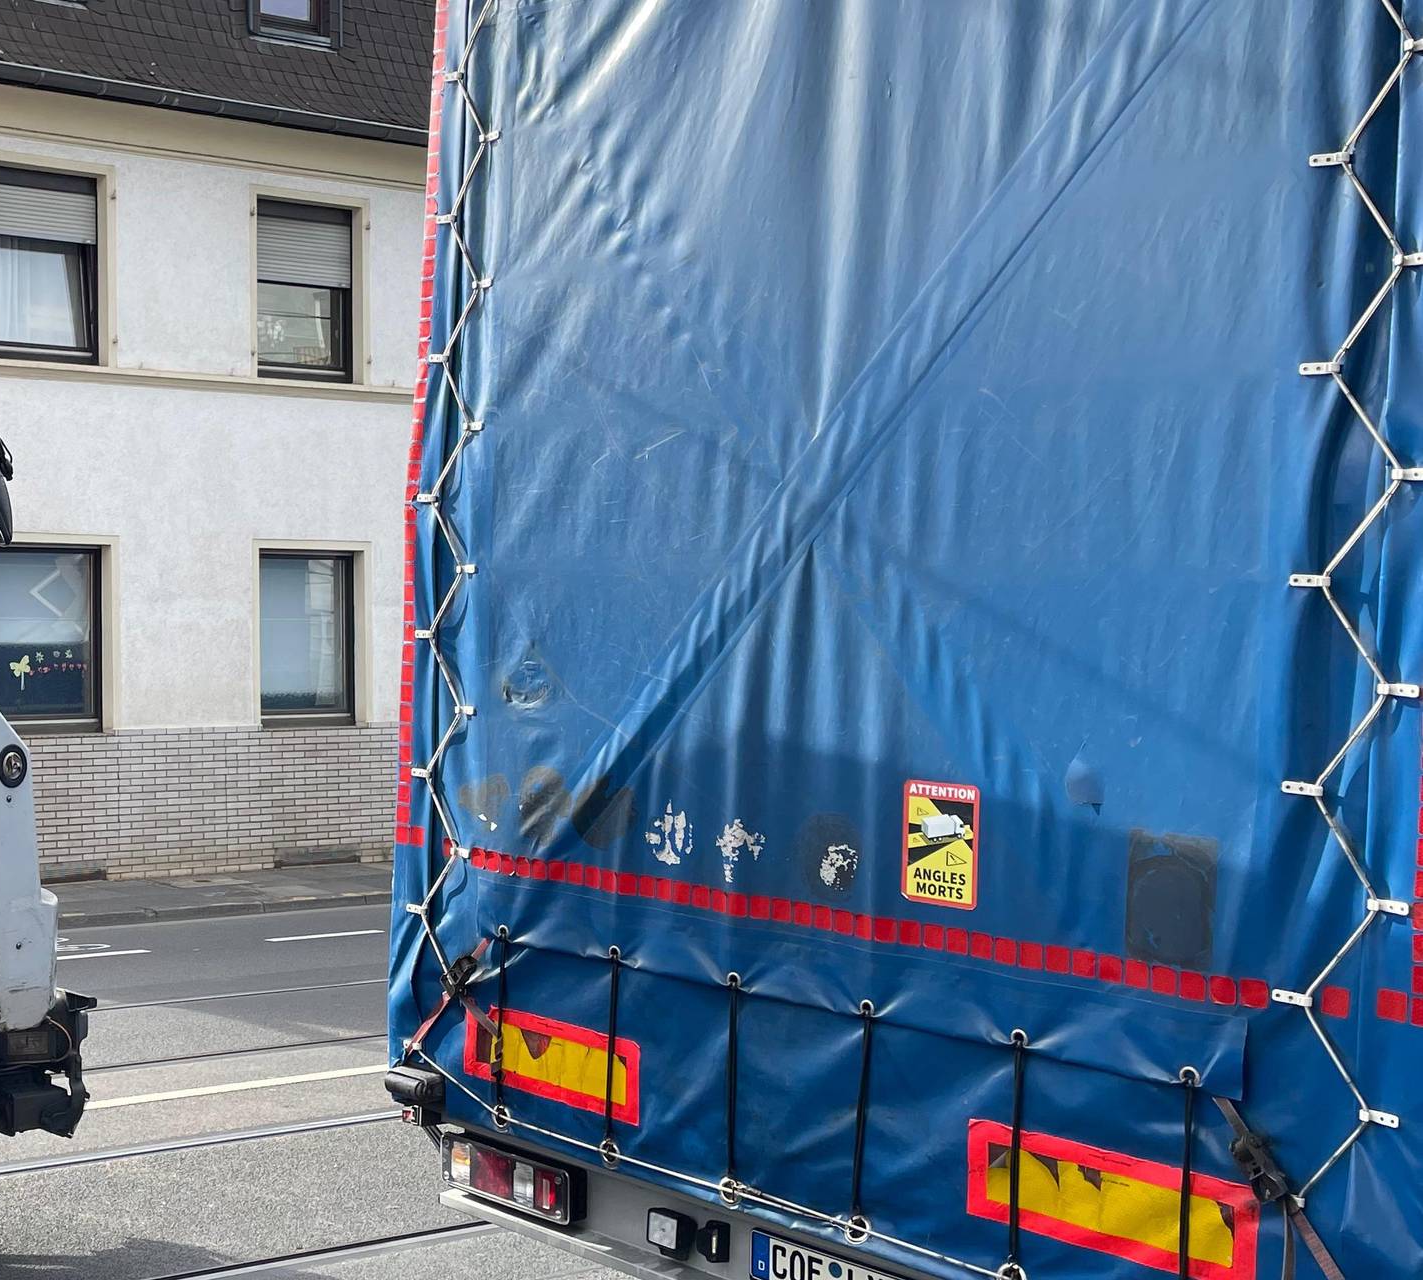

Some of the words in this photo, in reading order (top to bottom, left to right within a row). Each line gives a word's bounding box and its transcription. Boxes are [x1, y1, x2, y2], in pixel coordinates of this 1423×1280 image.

[909, 783, 976, 800] ATTENTION
[913, 867, 966, 886] ANGLES
[916, 882, 963, 900] MORTS
[757, 1260, 766, 1271] D
